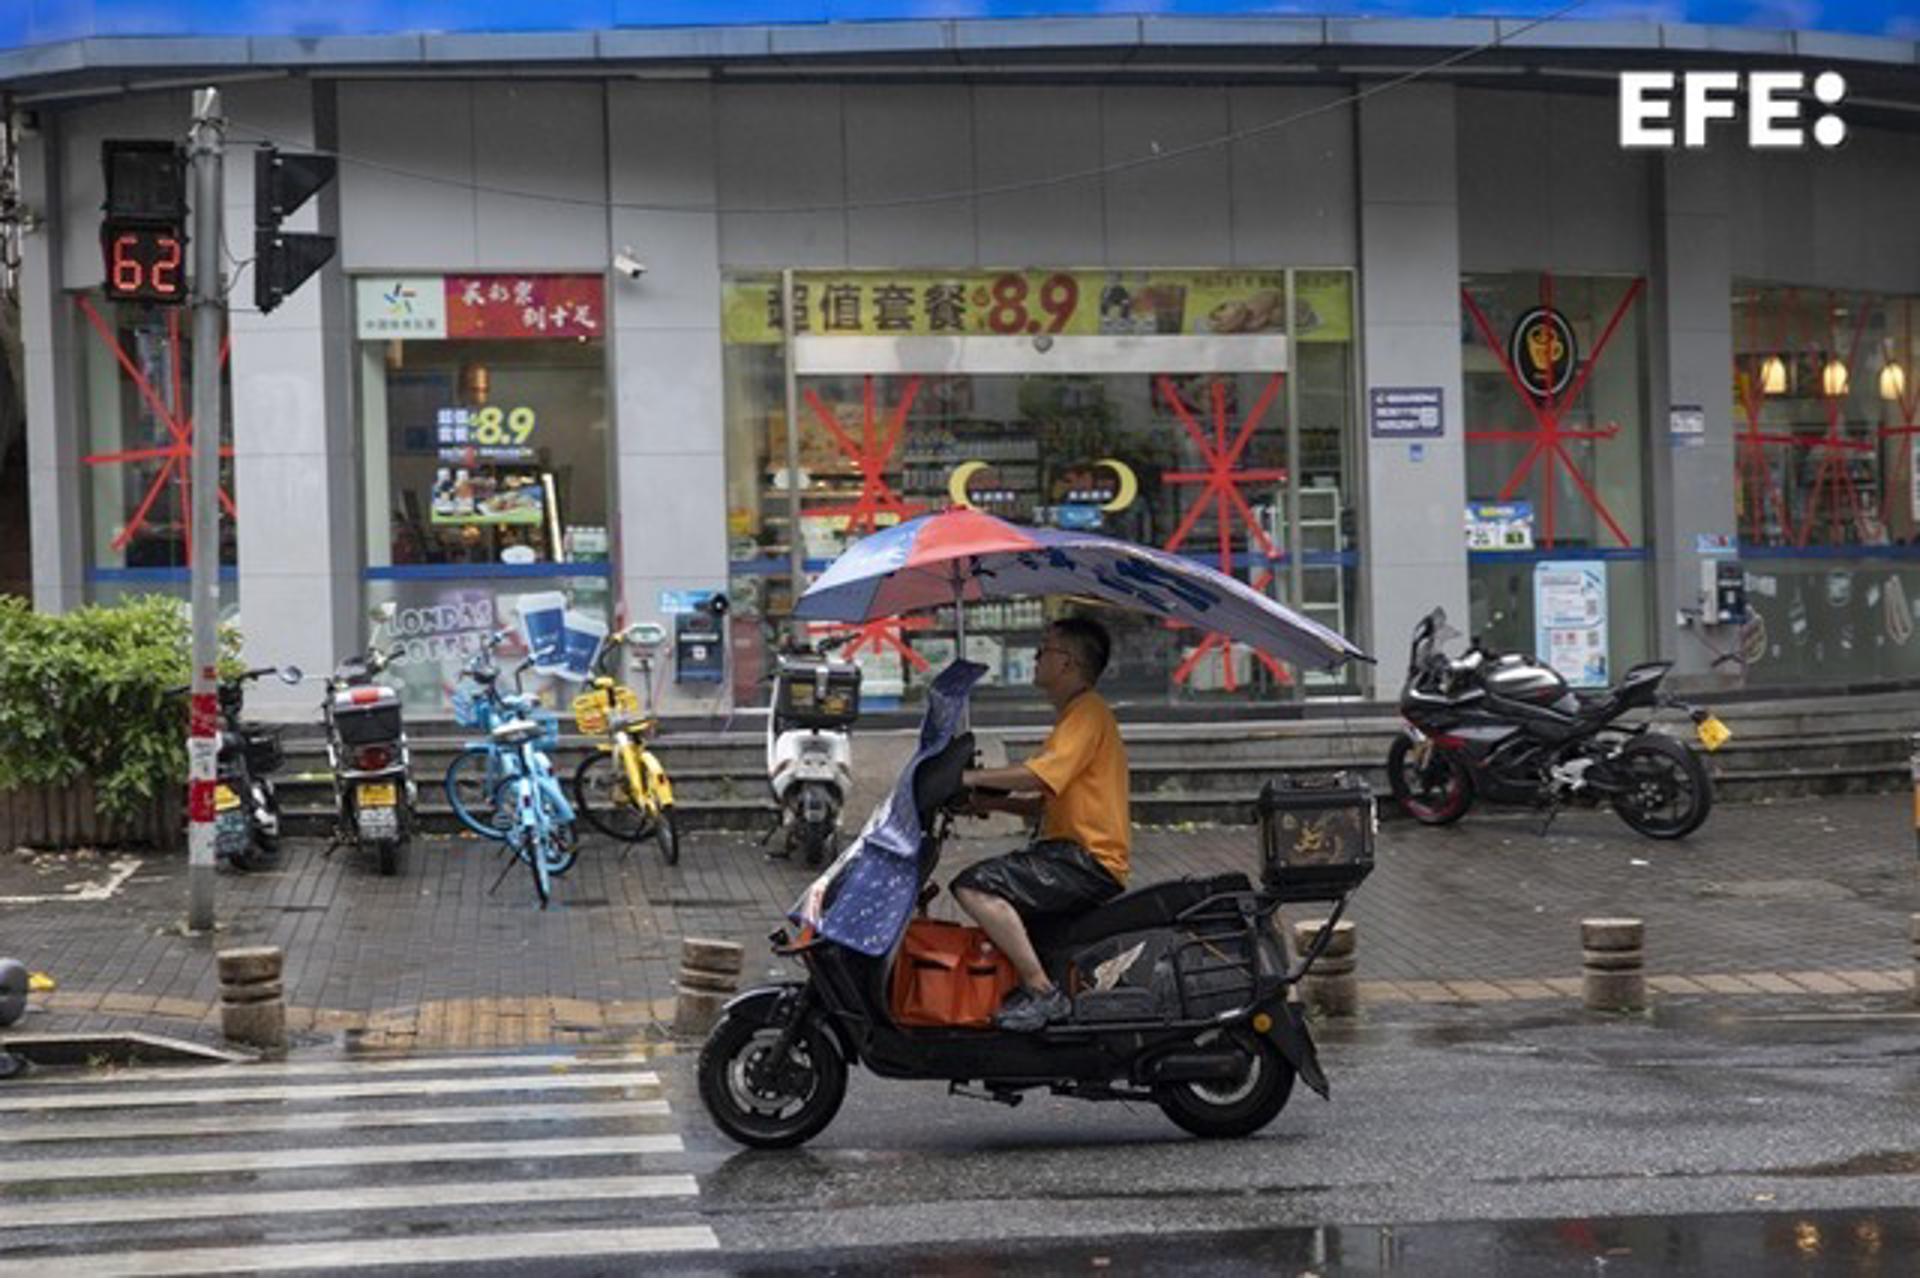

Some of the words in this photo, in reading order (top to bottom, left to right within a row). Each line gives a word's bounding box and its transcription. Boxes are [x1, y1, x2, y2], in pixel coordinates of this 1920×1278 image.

[113, 236, 181, 292] 62
[767, 283, 967, 335] 超值套餐
[986, 272, 1080, 335] 8.9
[477, 406, 535, 445] 8.9
